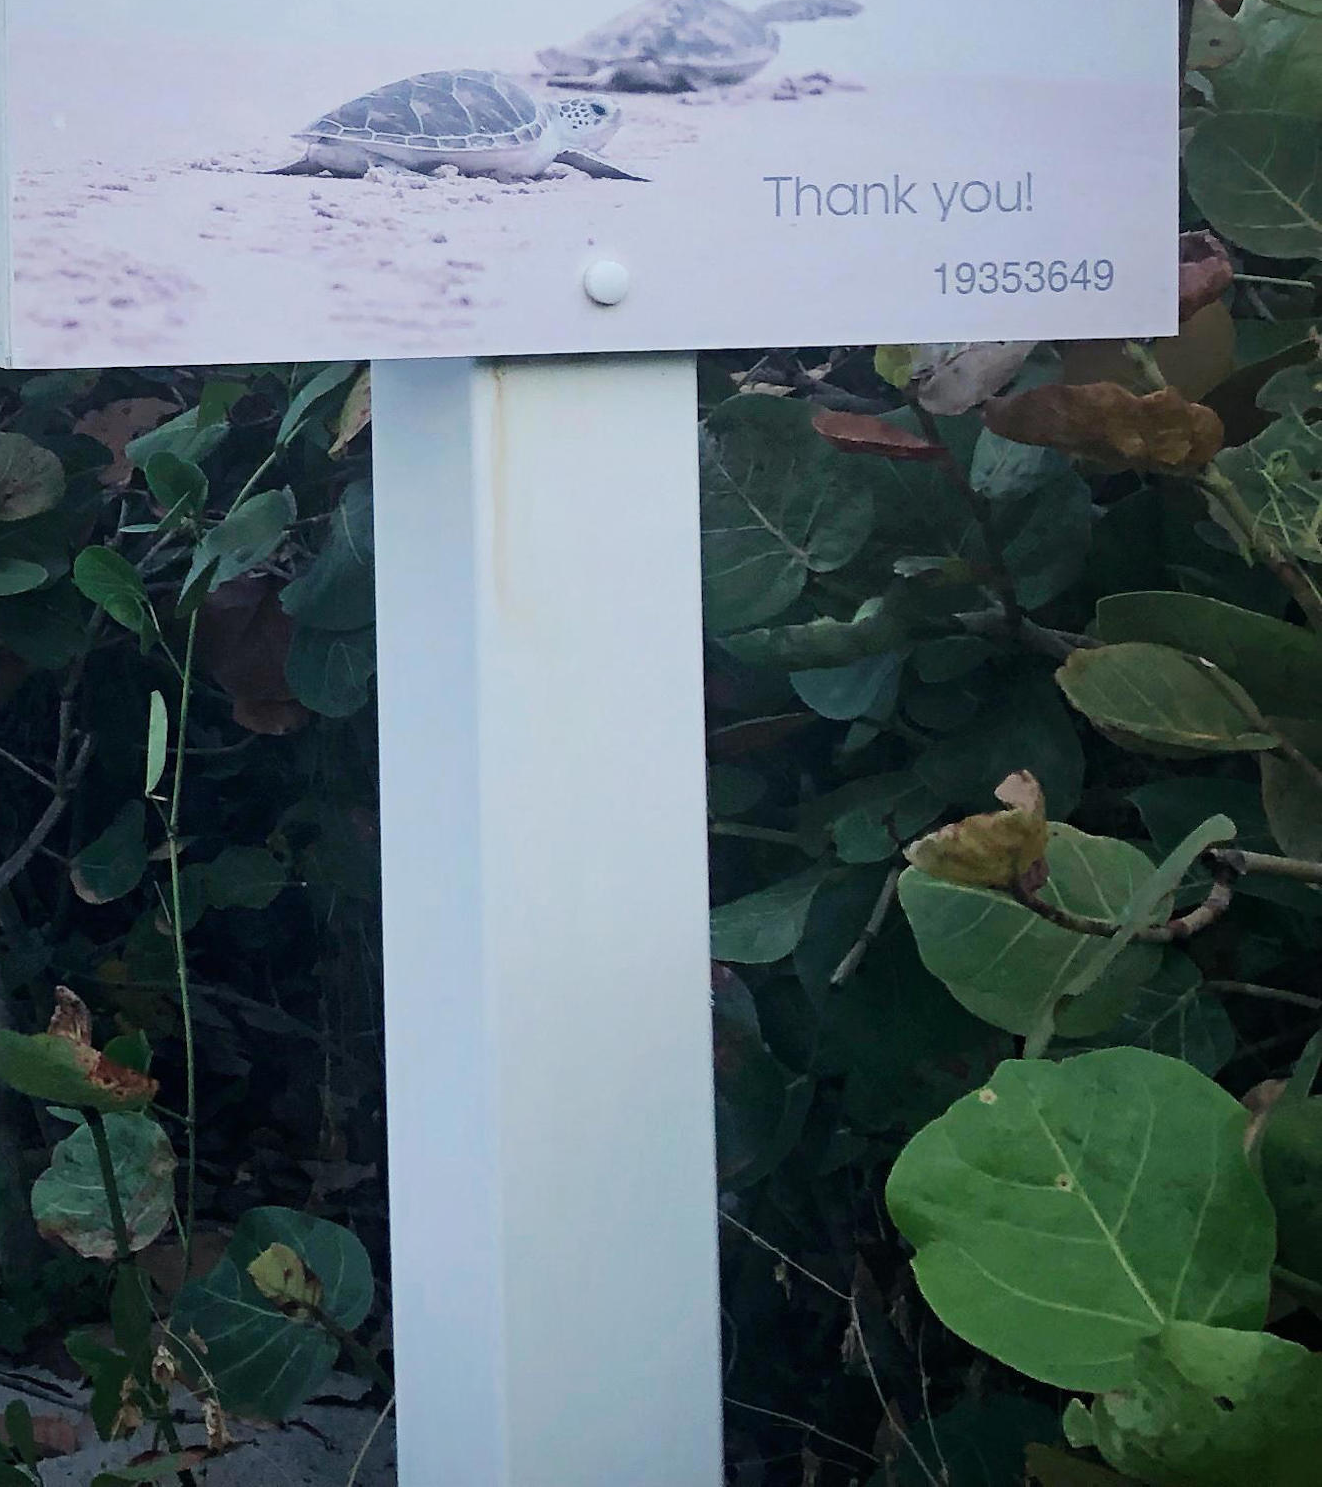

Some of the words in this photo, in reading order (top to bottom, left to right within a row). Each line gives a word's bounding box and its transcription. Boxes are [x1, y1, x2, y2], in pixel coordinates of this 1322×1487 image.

[763, 175, 917, 216] Thank
[932, 172, 1032, 222] you!
[935, 259, 1113, 294] 19353649
